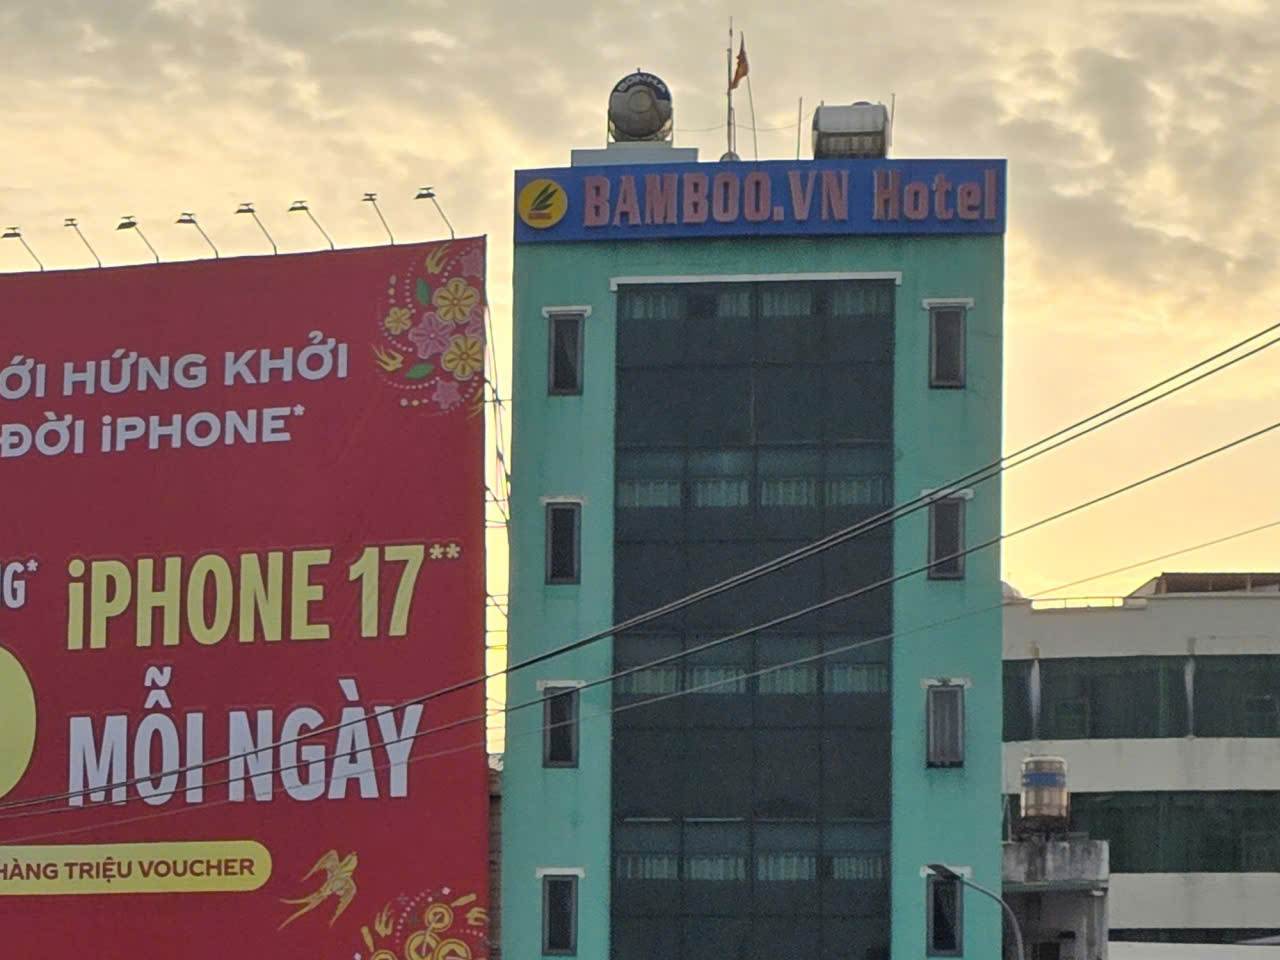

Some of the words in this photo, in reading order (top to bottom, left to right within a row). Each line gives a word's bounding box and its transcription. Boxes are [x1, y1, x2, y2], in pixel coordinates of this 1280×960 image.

[582, 169, 850, 227] BAMBOO.VN
[872, 168, 998, 221] Hotel
[62, 348, 208, 397] HỨNG
[223, 329, 349, 387] KHỞI
[0, 411, 85, 459] ĐỜI
[66, 547, 333, 652] iPHONE
[66, 665, 205, 808] MỖI
[226, 677, 425, 805] NGÀY
[63, 856, 133, 884] TRIỆU
[137, 857, 257, 879] VOUCHER
